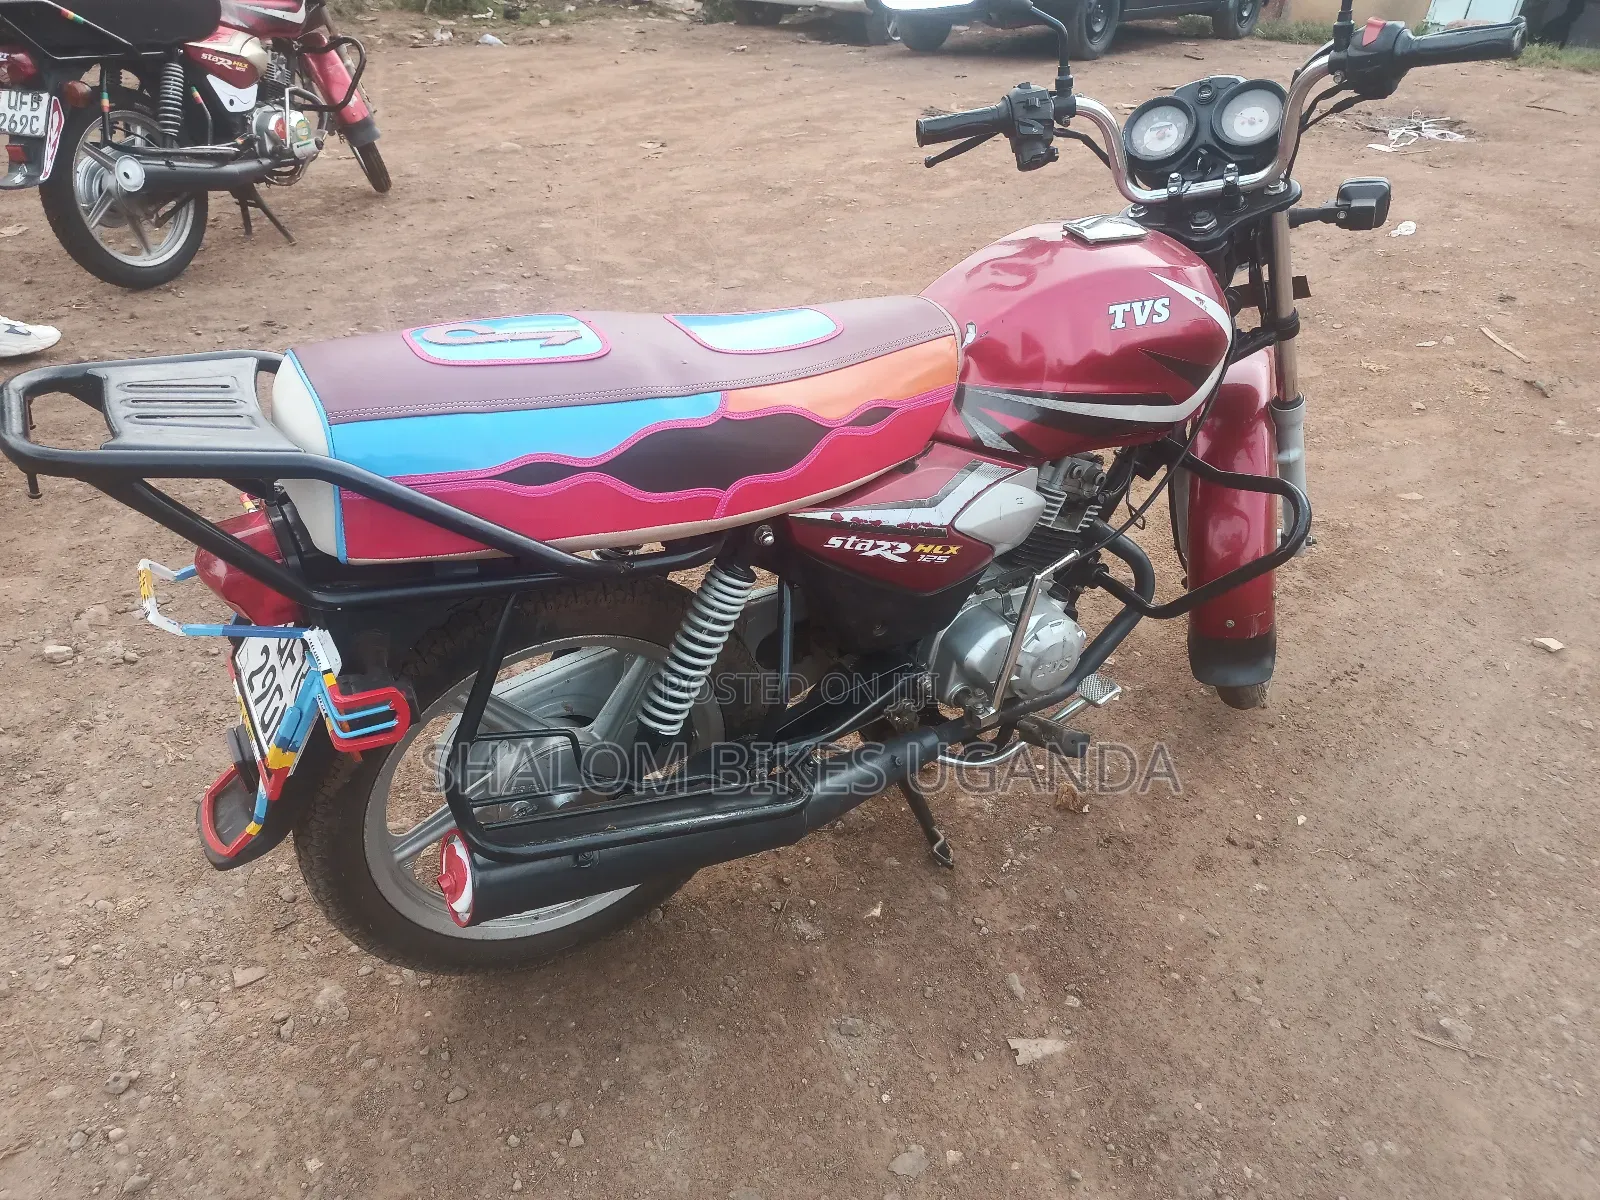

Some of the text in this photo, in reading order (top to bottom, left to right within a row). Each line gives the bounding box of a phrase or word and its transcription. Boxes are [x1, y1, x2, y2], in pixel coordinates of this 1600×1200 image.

[1108, 297, 1170, 330] TVS
[913, 542, 963, 554] HLX
[917, 554, 951, 563] 125
